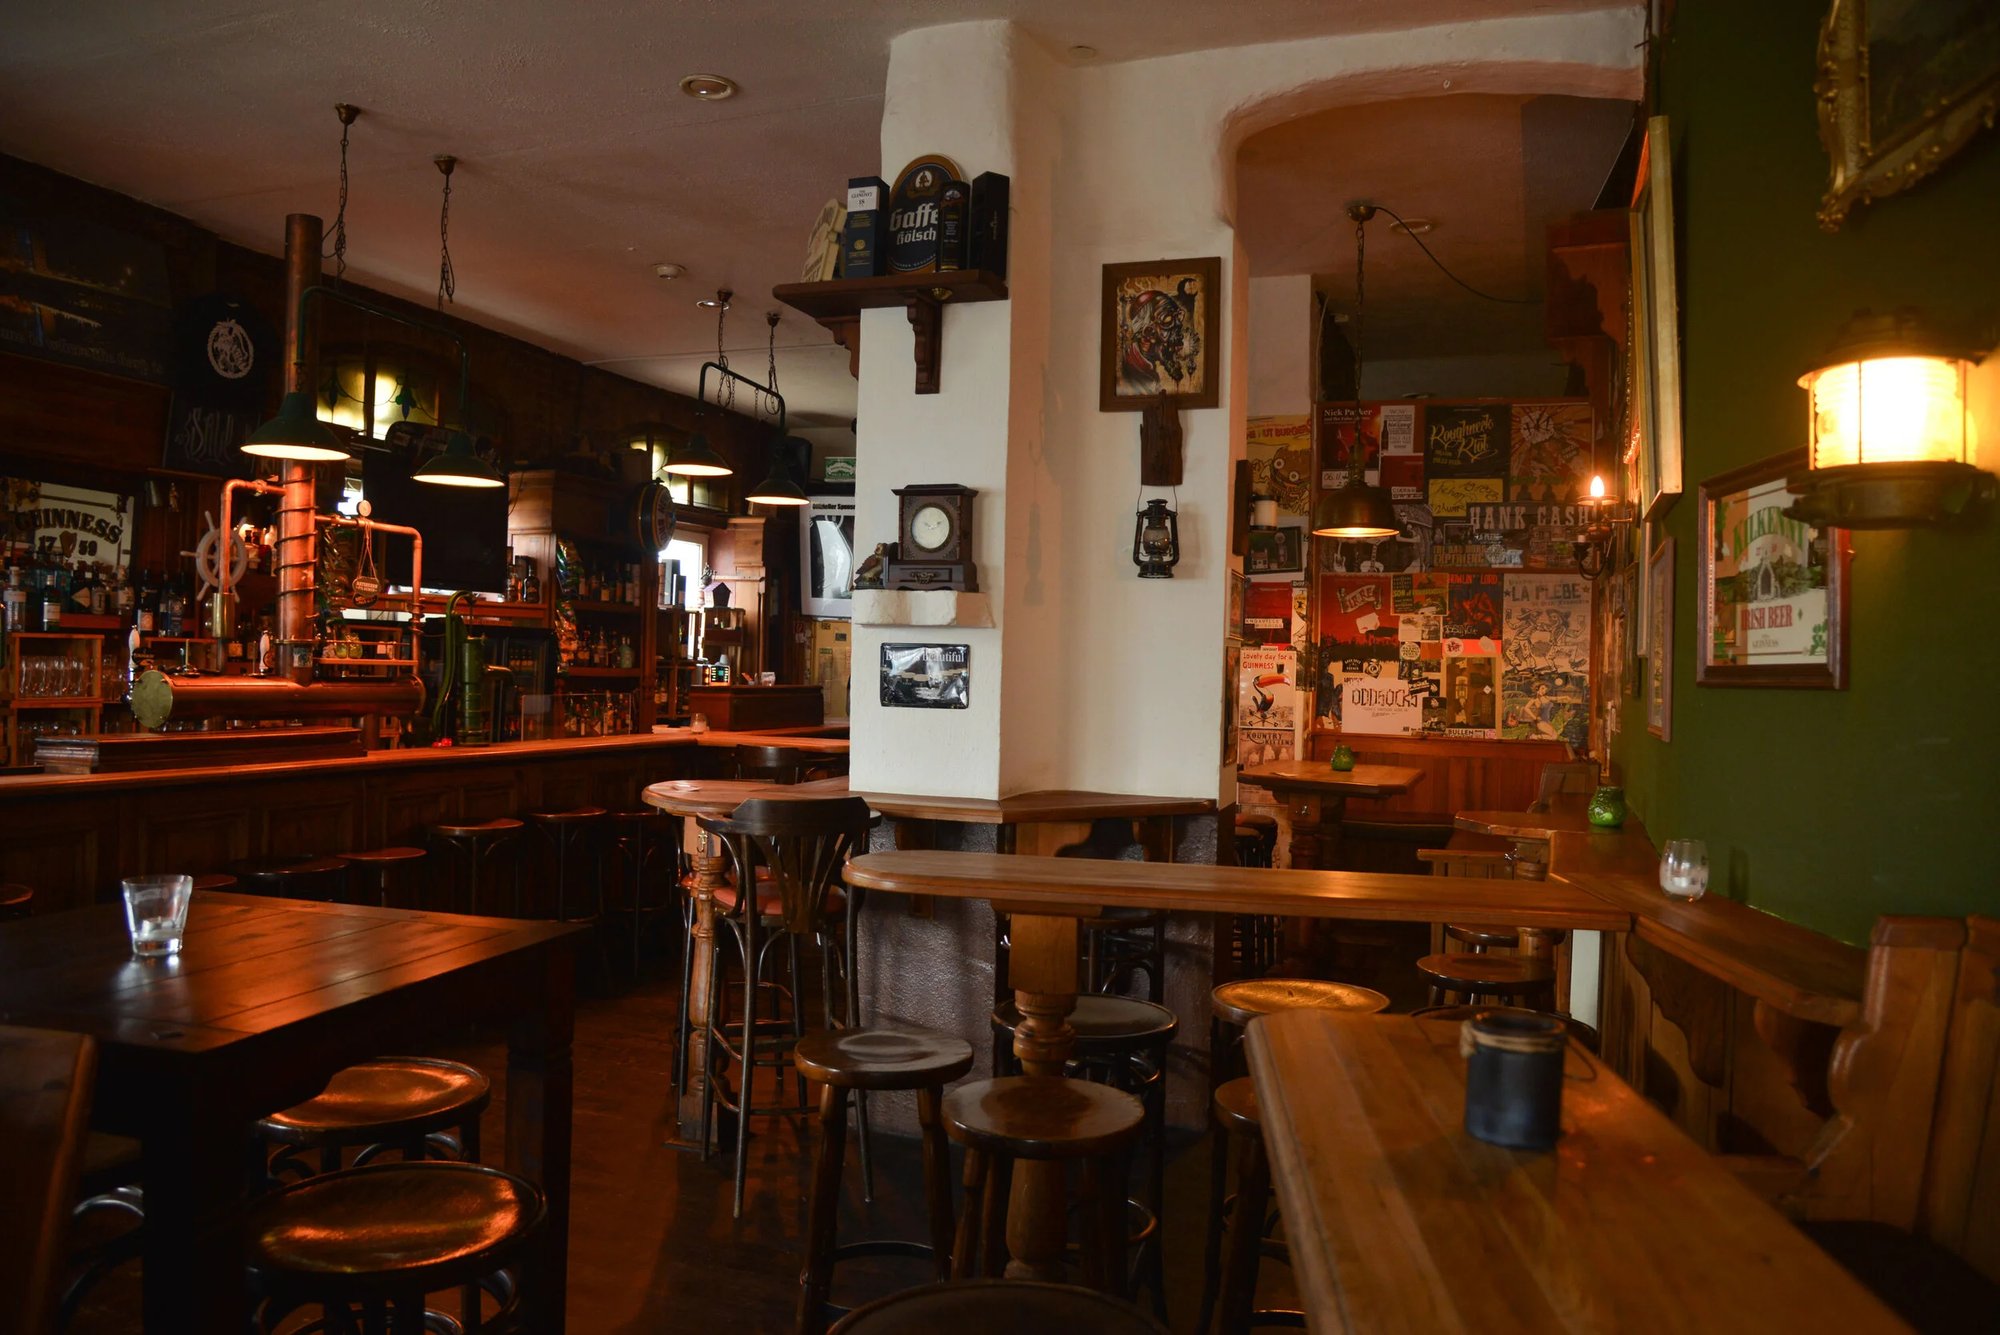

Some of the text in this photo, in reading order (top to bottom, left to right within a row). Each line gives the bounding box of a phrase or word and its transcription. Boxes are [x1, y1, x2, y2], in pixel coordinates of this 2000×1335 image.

[889, 203, 938, 231] Gaffe
[1345, 408, 1373, 416] Paker
[15, 508, 123, 544] GUINNESS
[1470, 507, 1589, 529] HANK CASH
[79, 540, 98, 556] 59
[1512, 583, 1581, 601] LA PLEBE
[1741, 604, 1793, 631] IRISH BEER
[1243, 652, 1262, 660] Lovely
